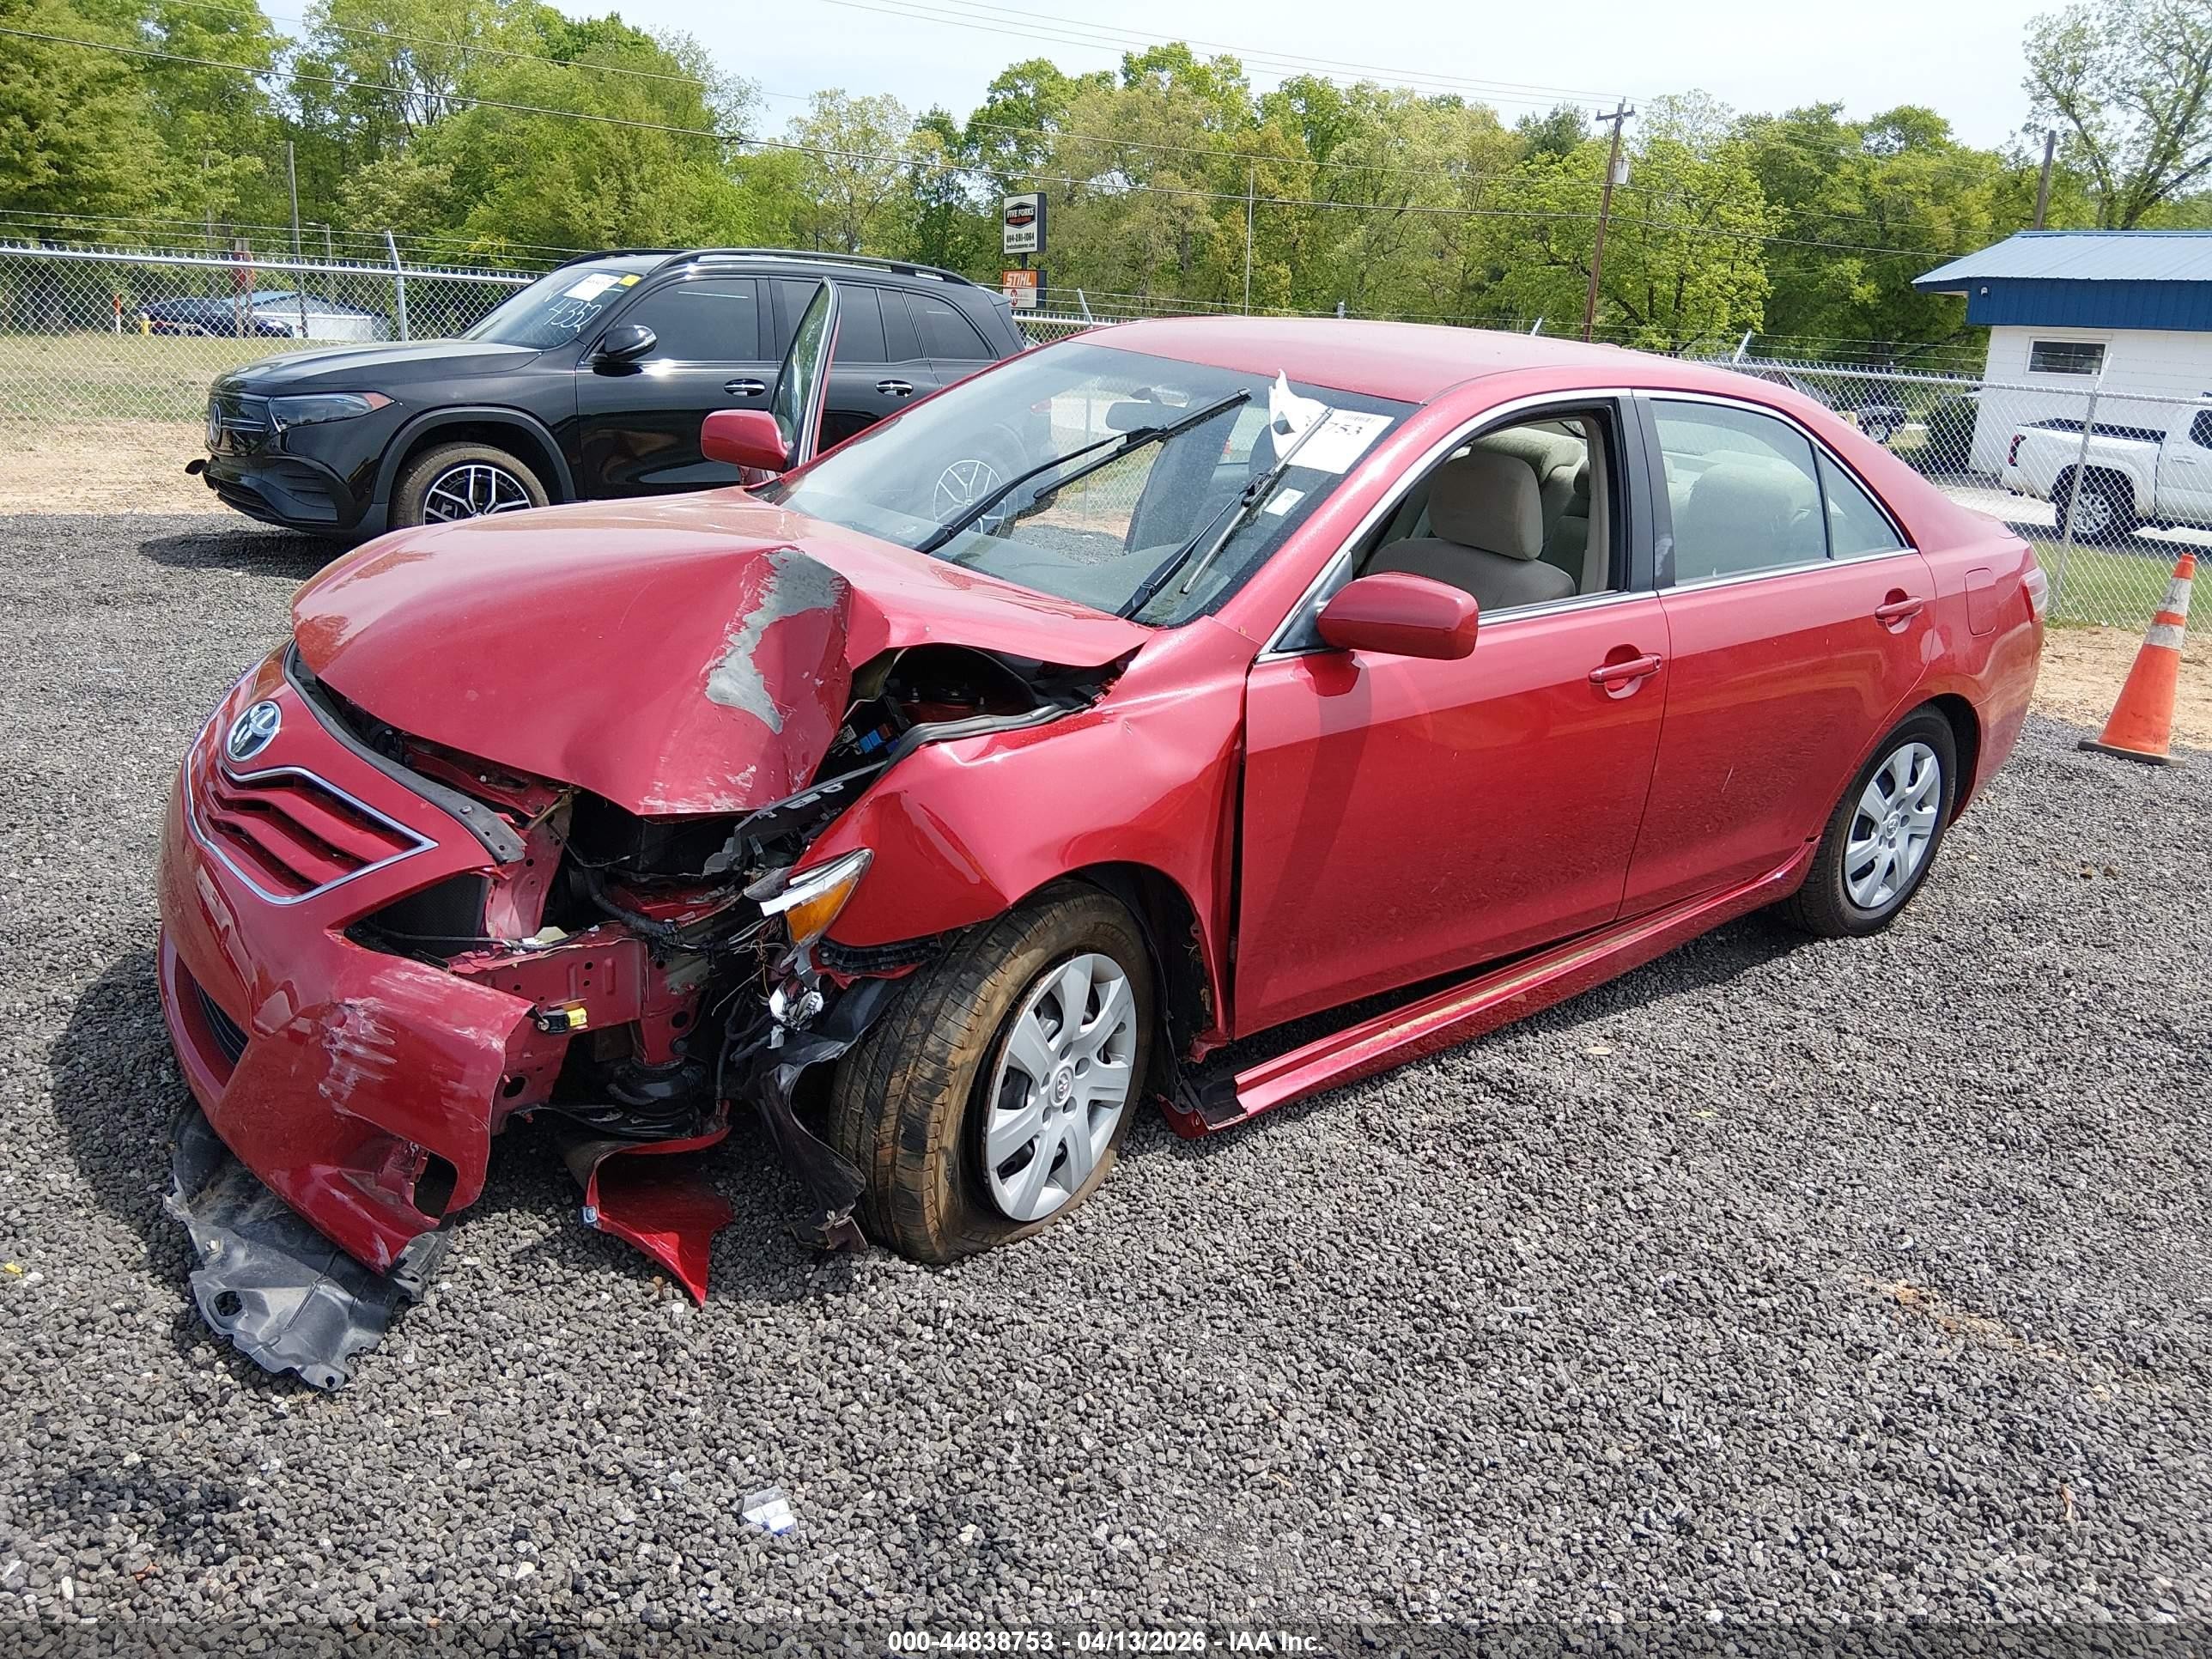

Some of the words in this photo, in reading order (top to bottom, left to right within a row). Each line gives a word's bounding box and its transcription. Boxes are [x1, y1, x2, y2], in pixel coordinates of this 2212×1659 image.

[1006, 210, 1018, 218] FIVE
[1018, 208, 1034, 217] FORKS
[1006, 273, 1031, 286] STIHL
